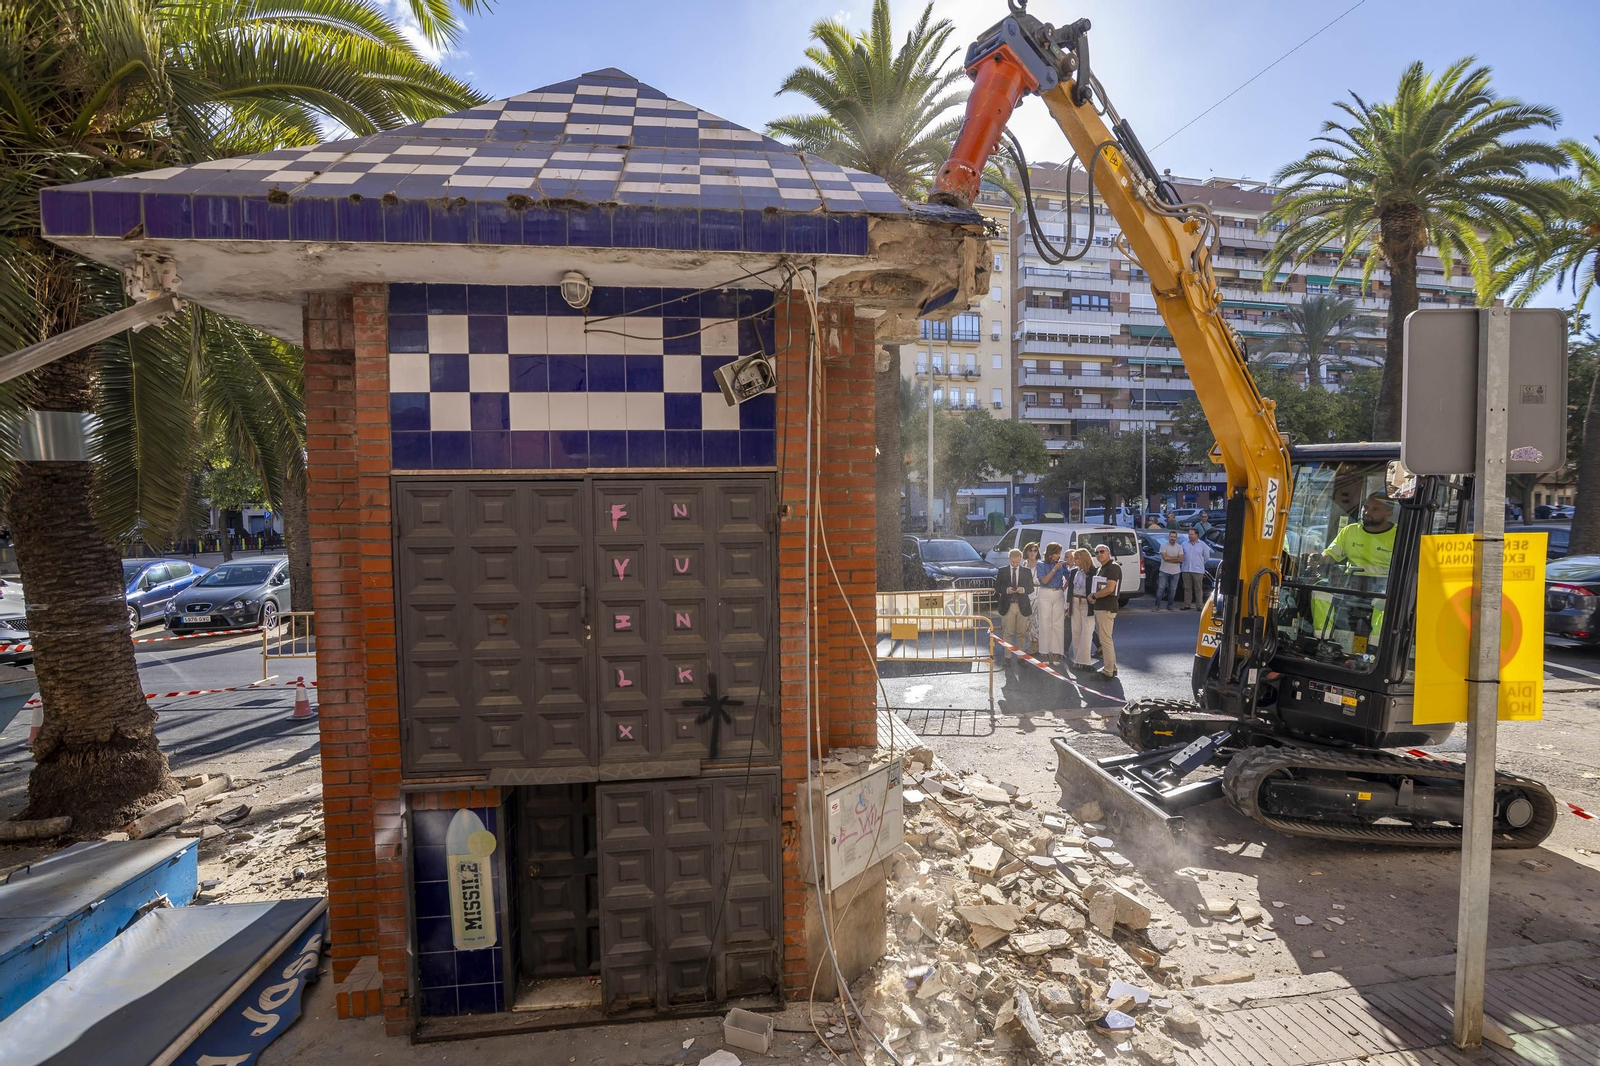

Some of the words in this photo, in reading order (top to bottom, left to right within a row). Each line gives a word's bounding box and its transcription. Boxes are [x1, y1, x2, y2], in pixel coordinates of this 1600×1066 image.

[610, 503, 628, 532] F
[673, 503, 688, 518] N
[1263, 480, 1278, 537] AXOR
[613, 557, 630, 581] Y
[675, 557, 690, 573] U
[676, 613, 691, 628] N
[618, 669, 632, 688] L
[678, 666, 693, 683] K
[618, 724, 632, 739] X
[460, 862, 483, 931] MISSILE
